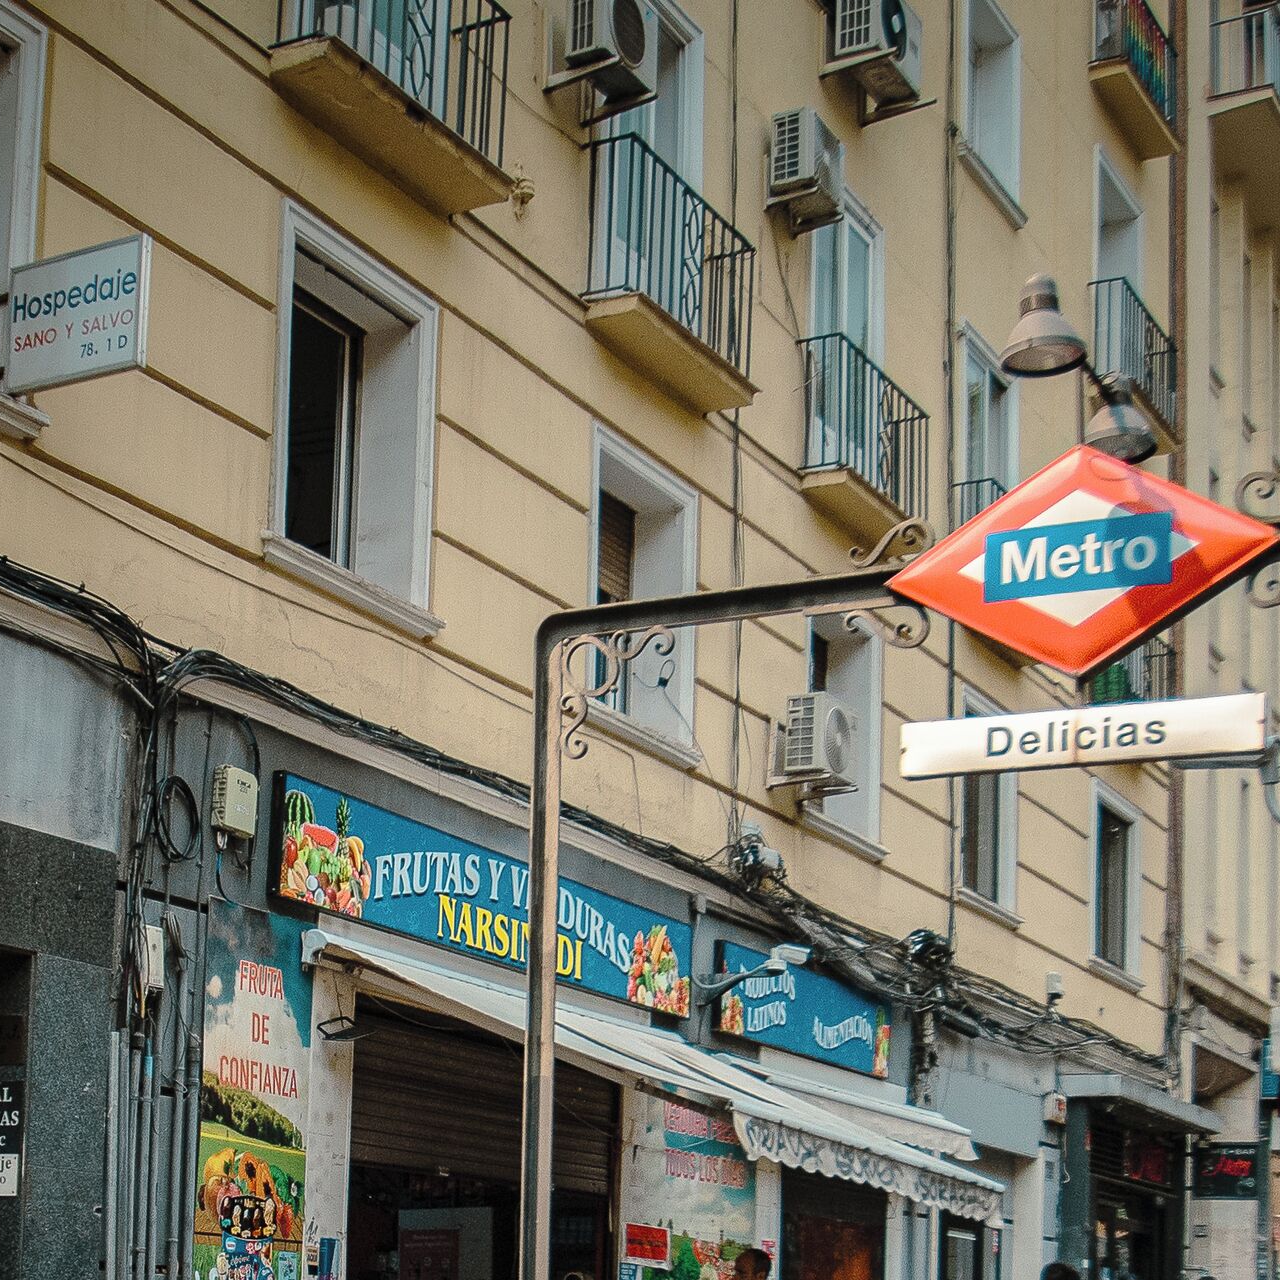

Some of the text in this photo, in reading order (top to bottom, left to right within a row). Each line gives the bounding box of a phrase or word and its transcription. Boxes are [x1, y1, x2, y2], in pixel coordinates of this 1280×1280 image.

[13, 268, 137, 323] Hospedaje
[14, 309, 134, 352] SANO Y SALVO
[107, 338, 111, 352] 1
[117, 335, 128, 349] D
[999, 532, 1157, 585] Metro
[985, 716, 1167, 758] Delicias
[374, 851, 631, 974] FRUTAS Y VDURAS
[438, 893, 583, 981] NARSINDI
[239, 960, 284, 1000] FRUTA
[251, 1012, 270, 1045] DE
[746, 1001, 787, 1032] LATINOS
[219, 1055, 298, 1099] CONFIANZA
